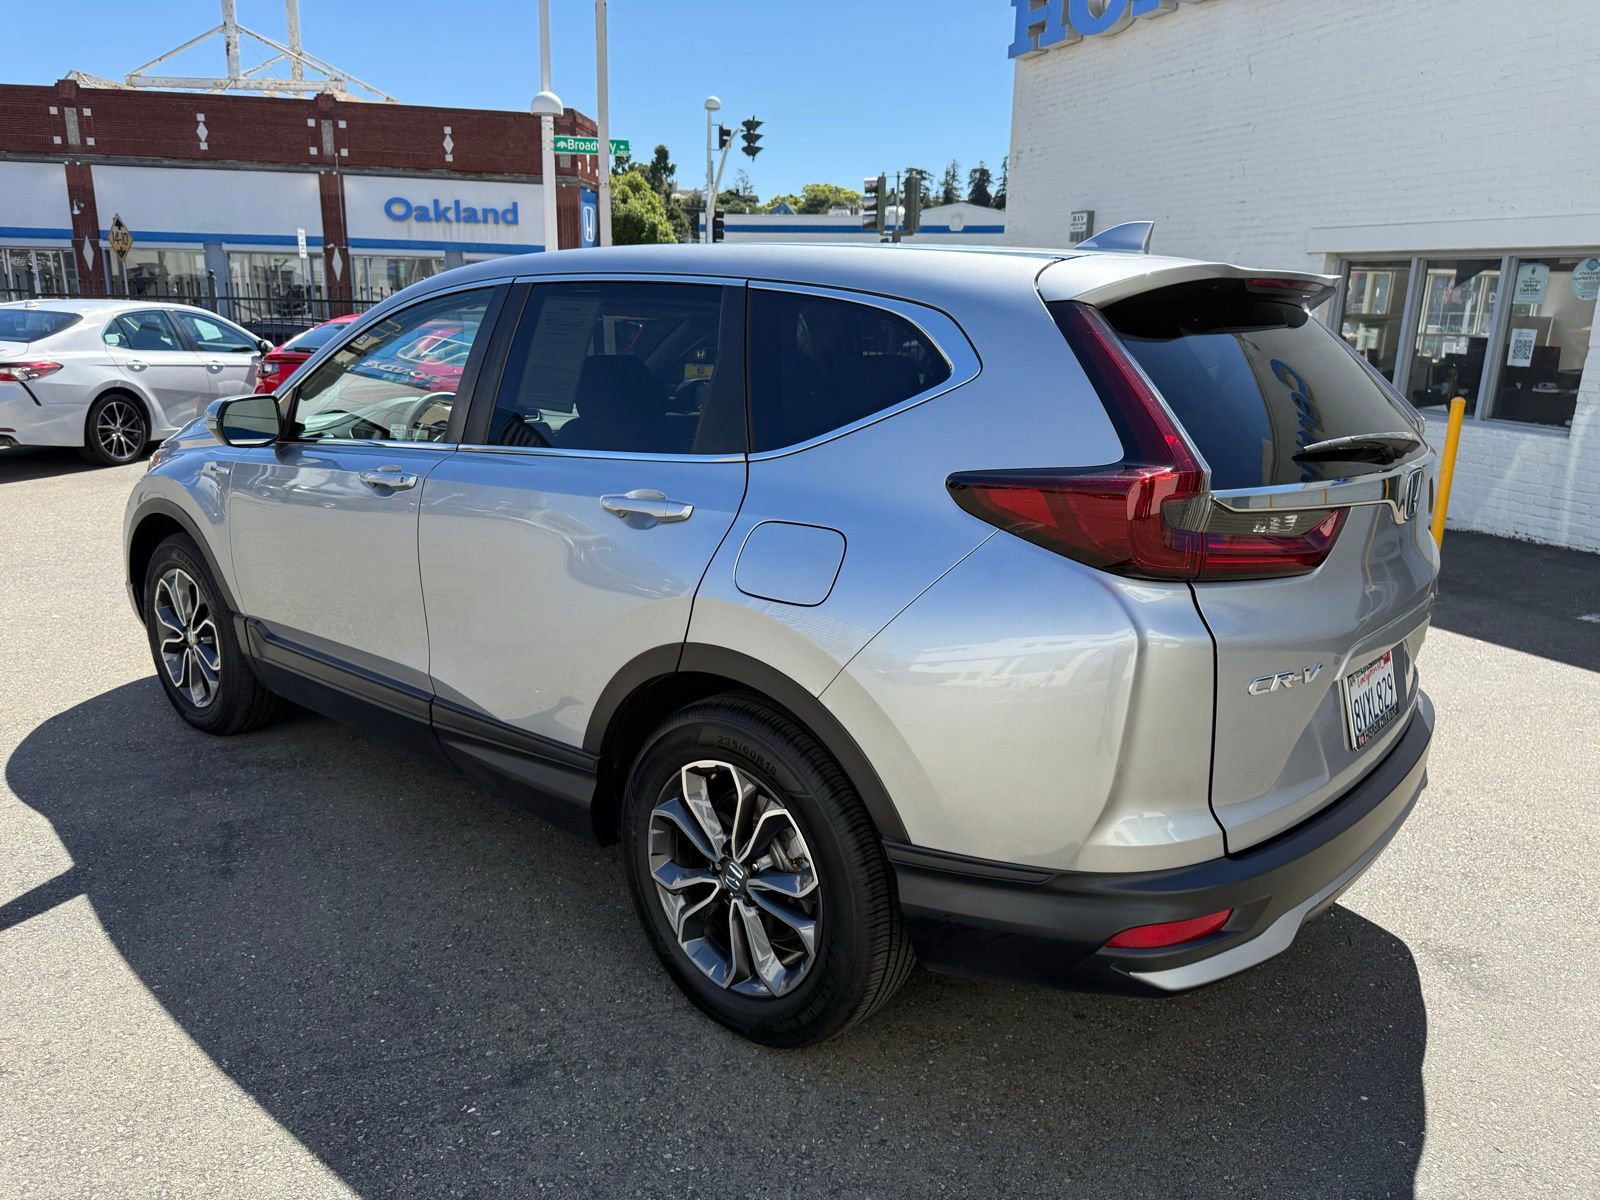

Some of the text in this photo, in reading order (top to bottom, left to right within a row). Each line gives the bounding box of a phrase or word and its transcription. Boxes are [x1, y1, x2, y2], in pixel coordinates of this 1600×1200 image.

[567, 139, 616, 155] Broady
[384, 197, 519, 225] Oakland
[1248, 662, 1324, 696] CR-V
[1353, 672, 1394, 734] 8VXL829
